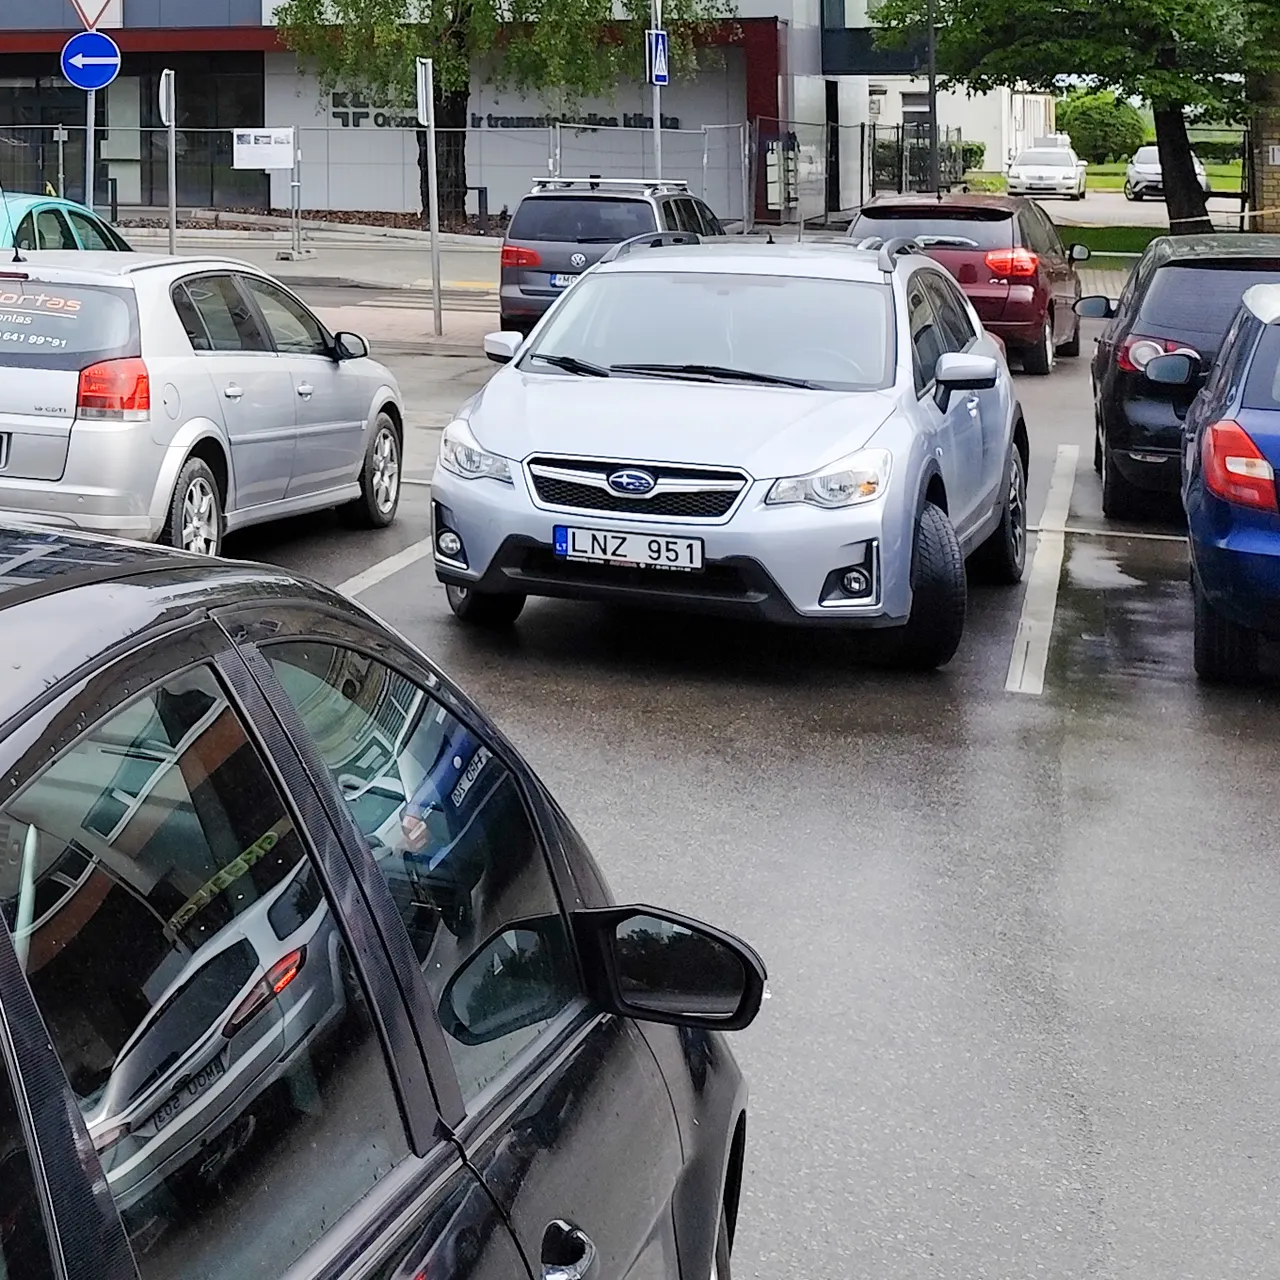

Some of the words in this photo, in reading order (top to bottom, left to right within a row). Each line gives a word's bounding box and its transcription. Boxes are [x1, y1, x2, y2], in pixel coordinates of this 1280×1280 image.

[471, 112, 483, 128] ir
[556, 541, 567, 551] LT
[572, 531, 628, 558] LNZ
[647, 539, 694, 565] 951
